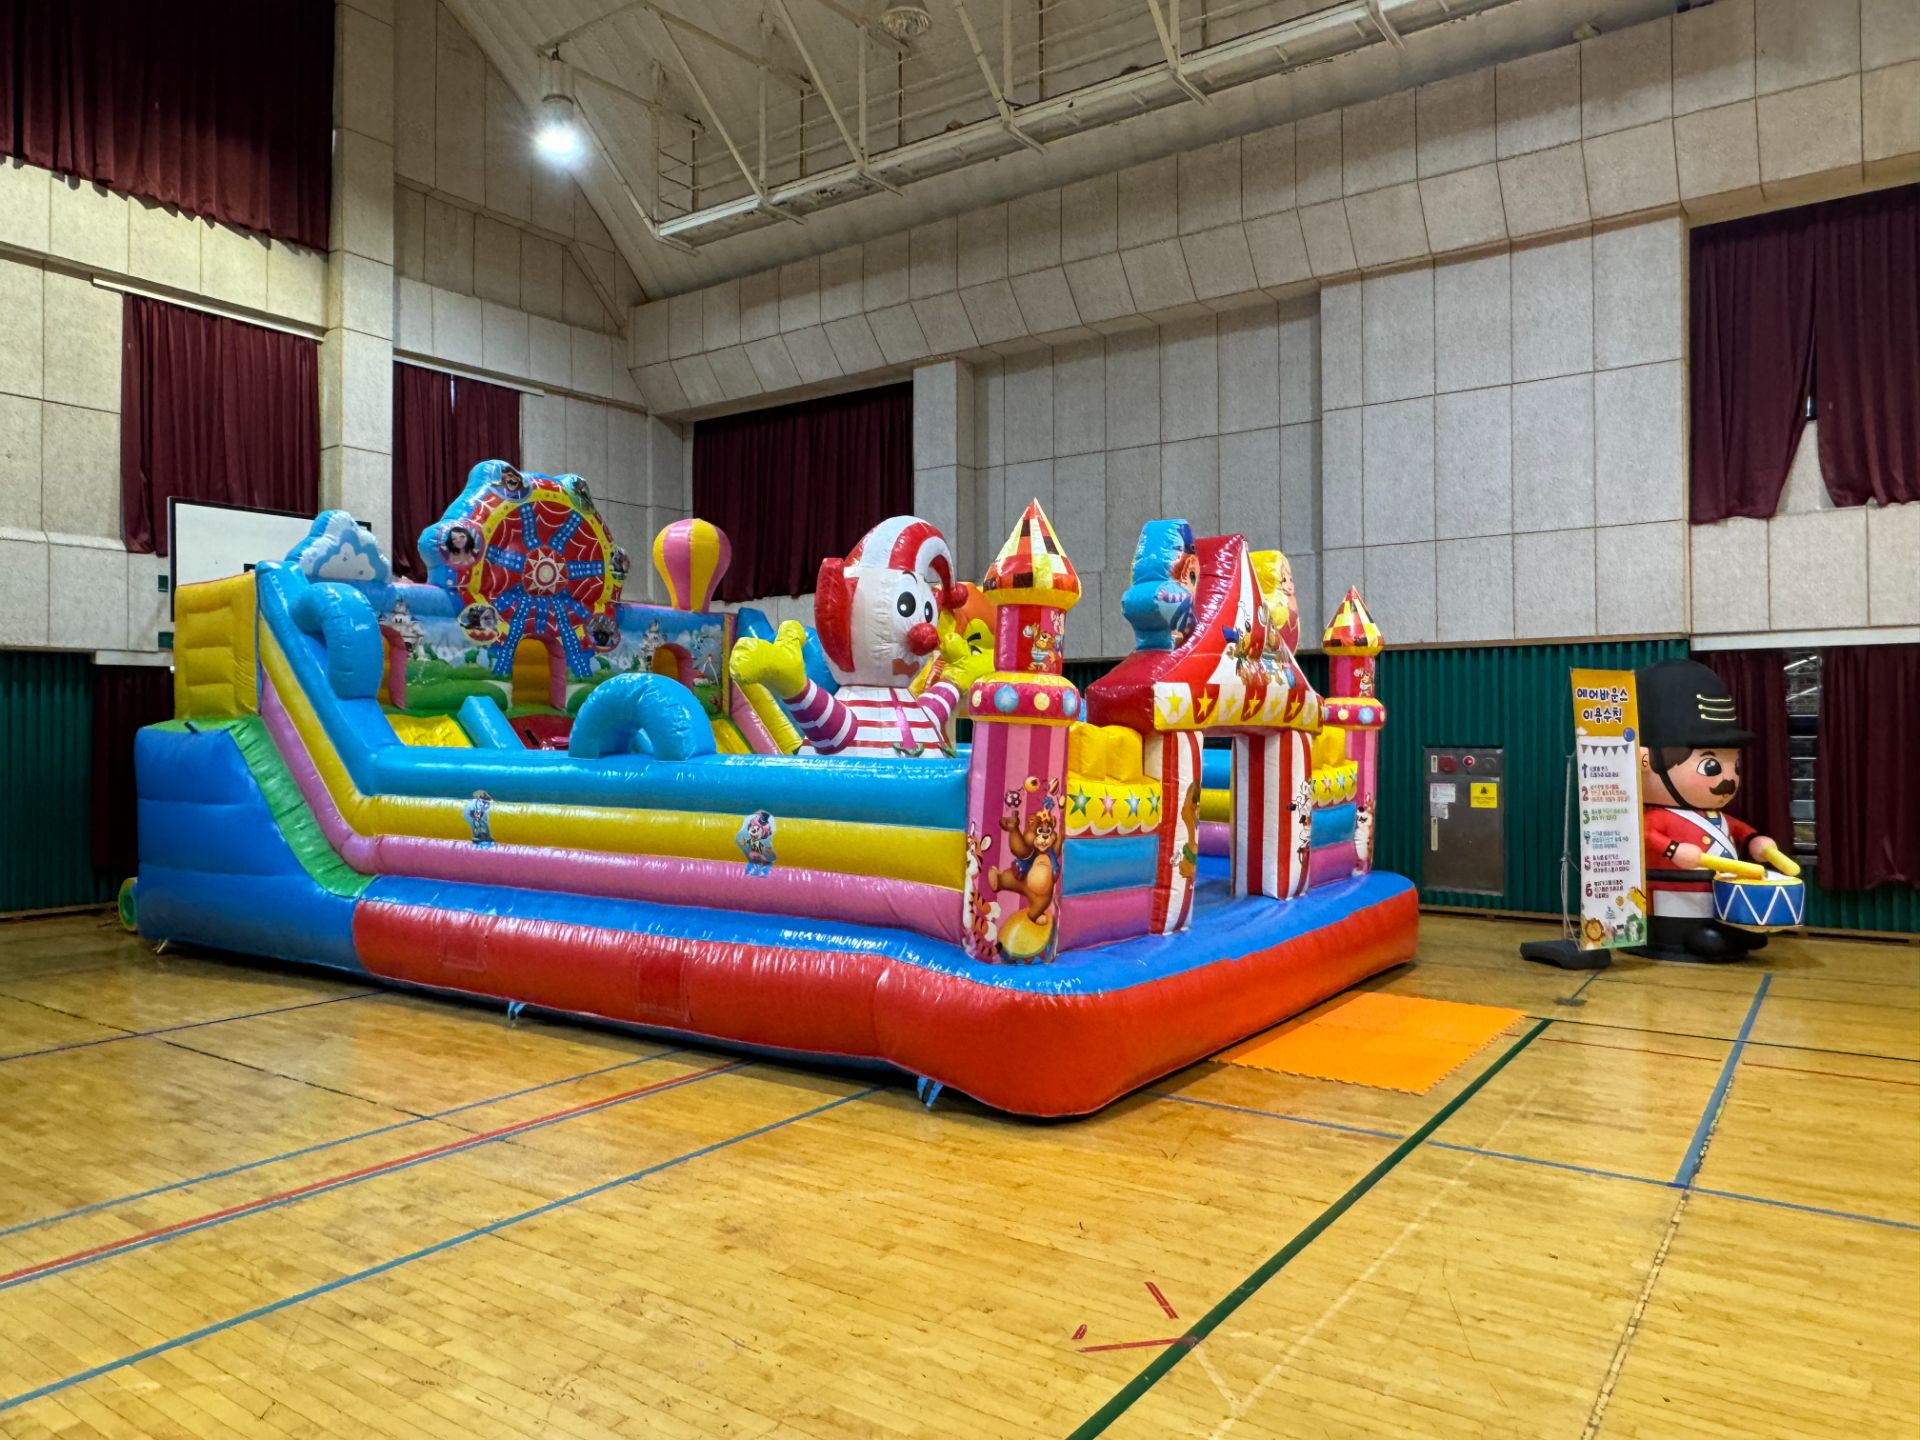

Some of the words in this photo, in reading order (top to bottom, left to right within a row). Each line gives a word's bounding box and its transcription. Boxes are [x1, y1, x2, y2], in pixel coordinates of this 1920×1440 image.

[1576, 688, 1628, 703] 에어바운스
[1582, 763, 1588, 778] 1
[1582, 786, 1589, 801] 2
[1583, 809, 1590, 824] 3
[1584, 855, 1591, 871] 5
[1585, 883, 1593, 897] 6
